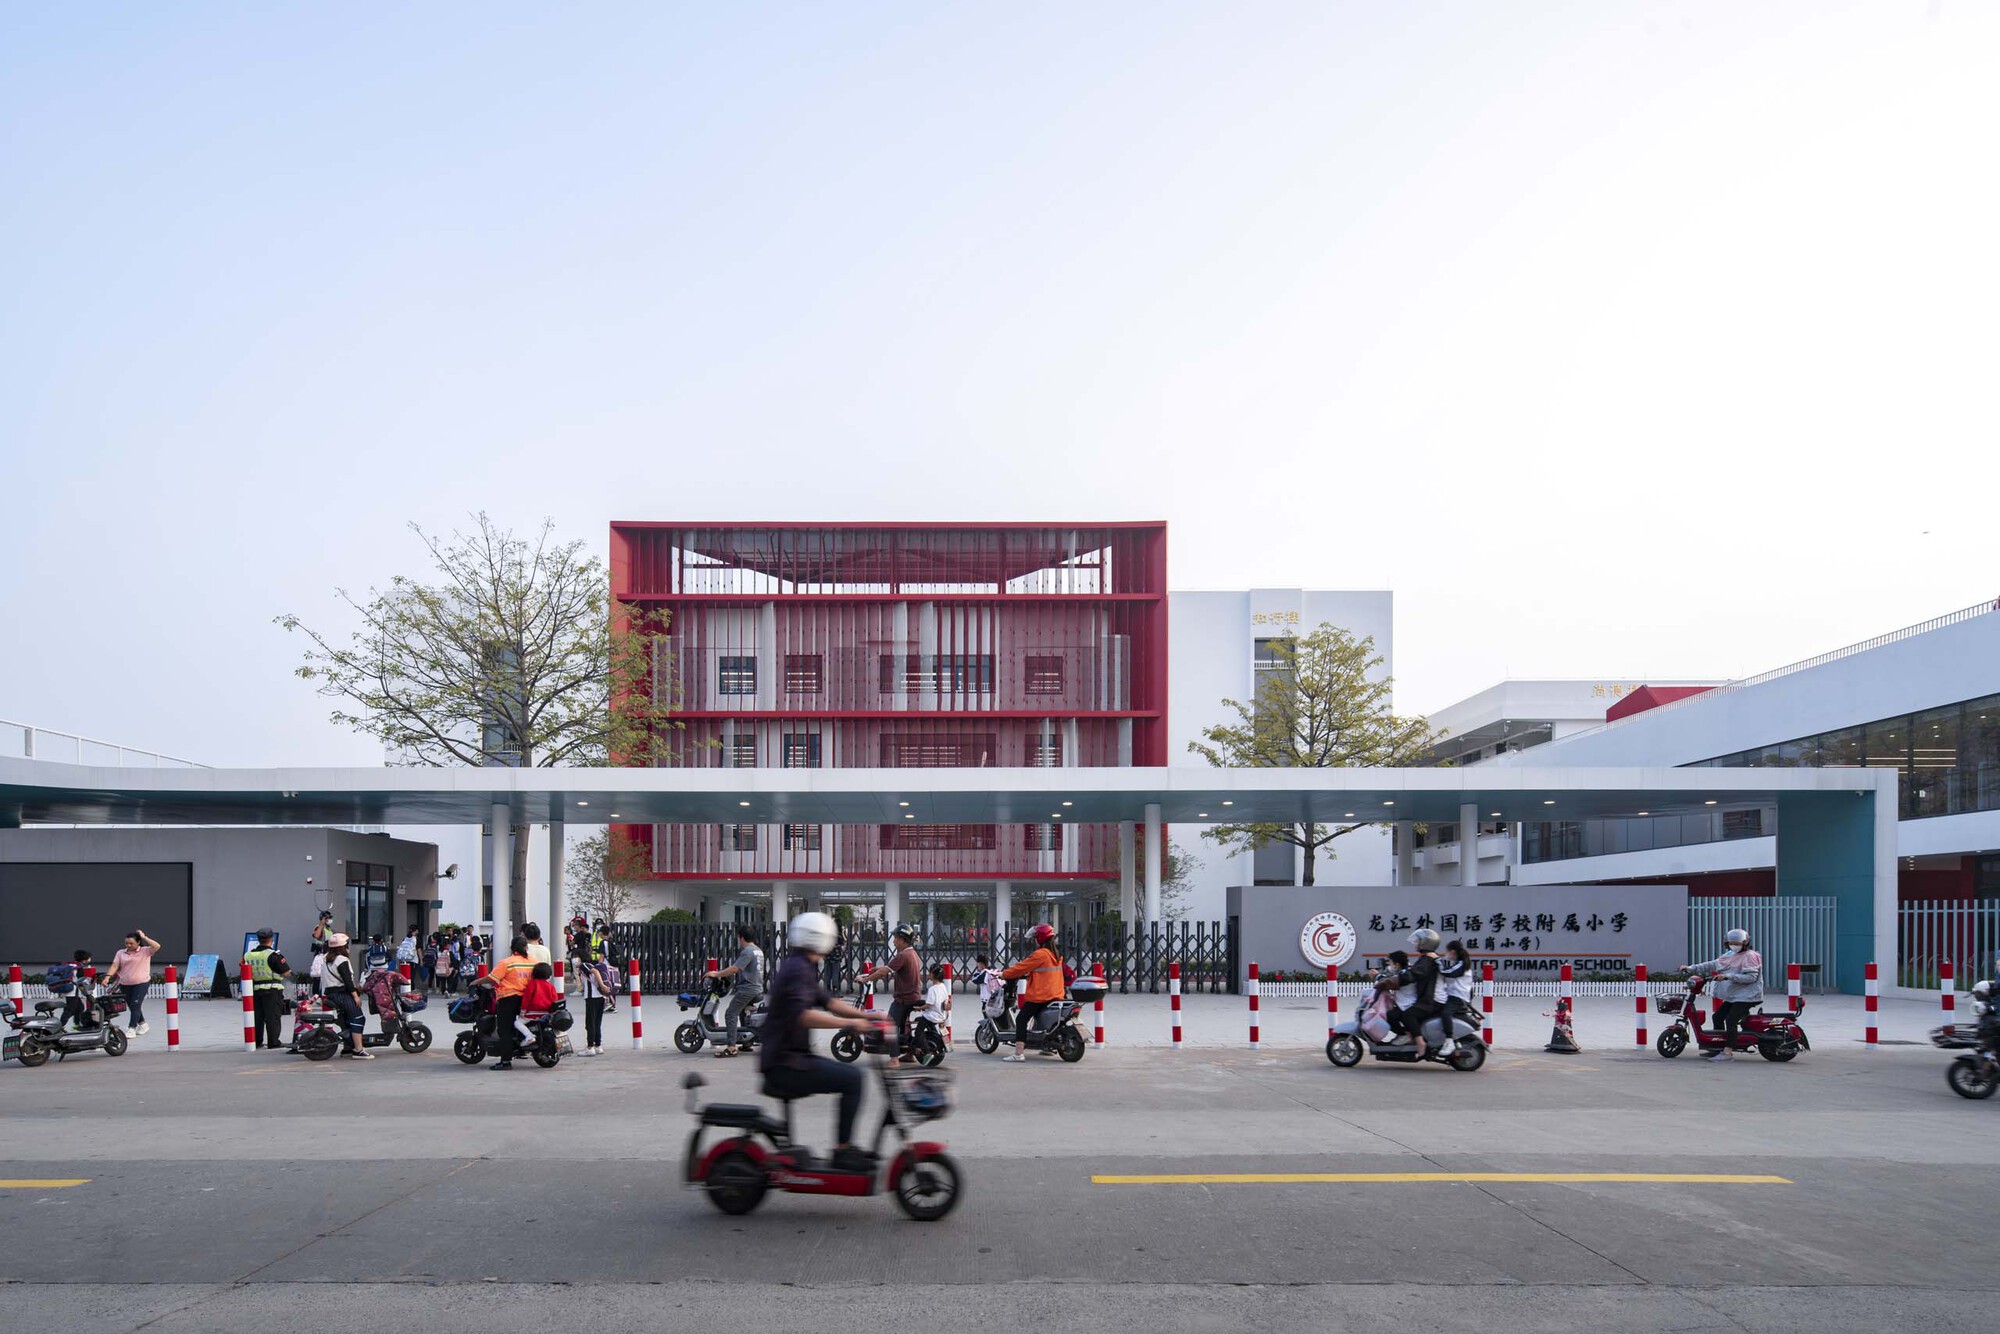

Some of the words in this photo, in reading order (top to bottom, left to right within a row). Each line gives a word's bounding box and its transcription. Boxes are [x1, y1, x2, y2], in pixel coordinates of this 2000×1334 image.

[1368, 912, 1628, 933] 龙江外国语学校附属小学
[1574, 959, 1631, 970] SCHOOL
